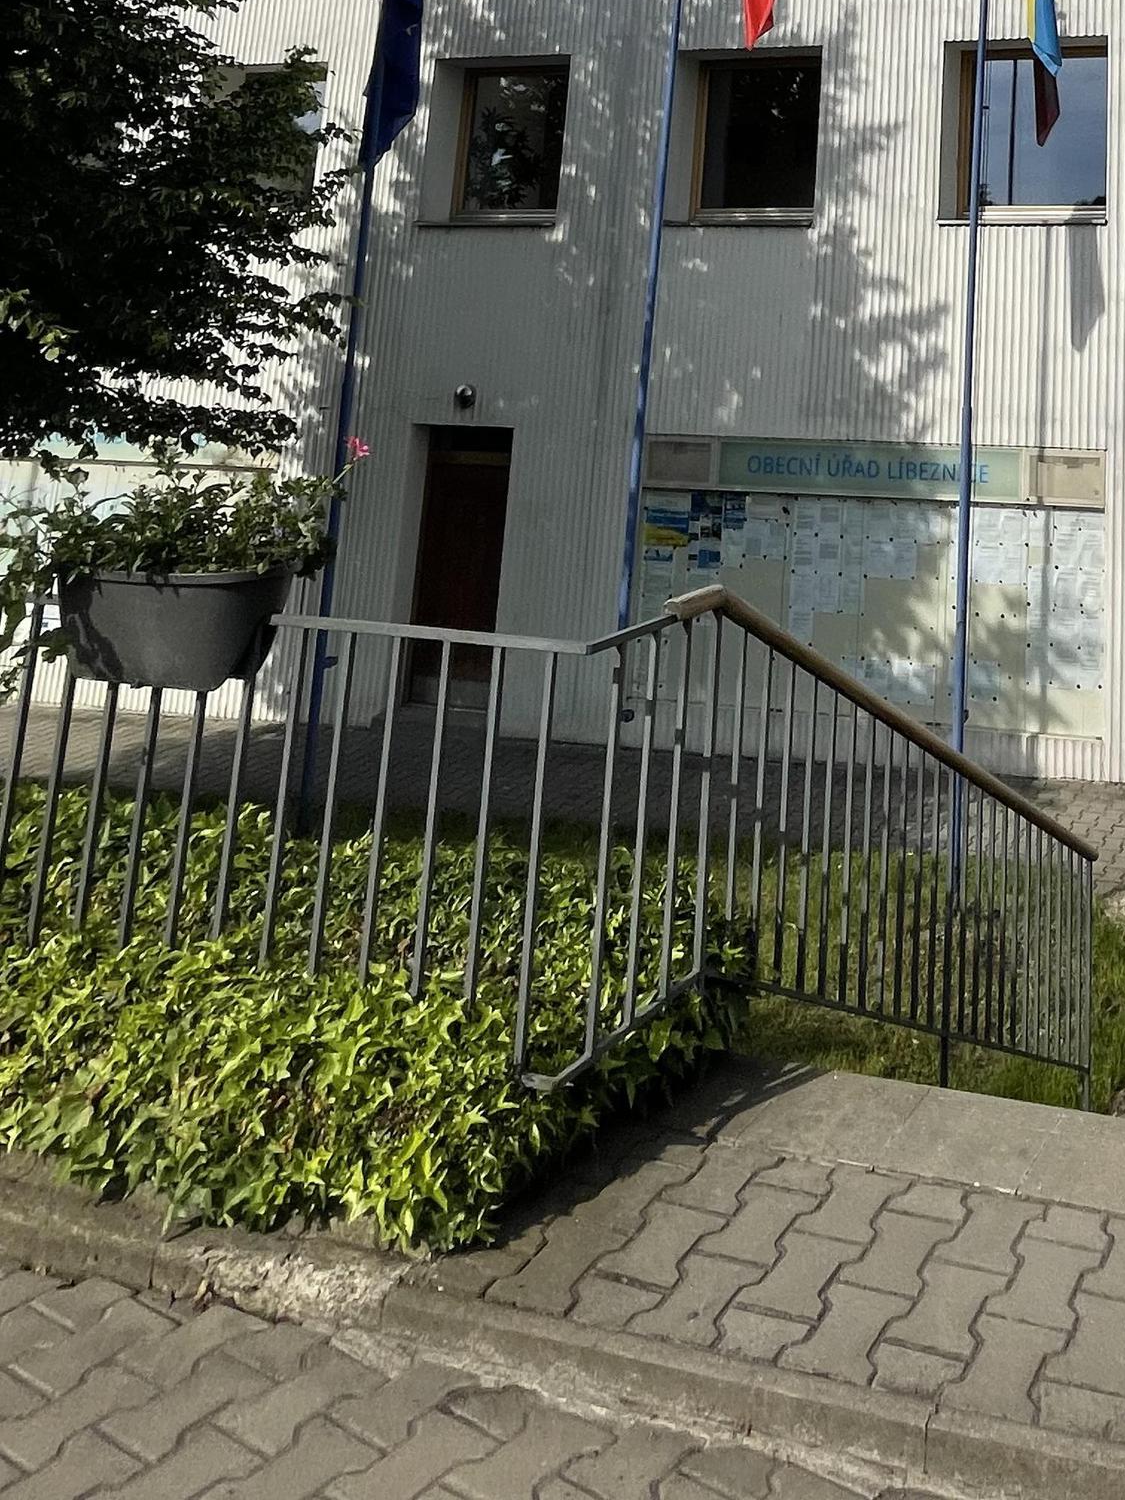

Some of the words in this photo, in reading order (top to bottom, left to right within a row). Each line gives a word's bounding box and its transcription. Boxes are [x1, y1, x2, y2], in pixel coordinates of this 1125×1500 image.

[747, 452, 821, 476] OBECNÍ
[827, 452, 880, 478] ÚŘAD
[887, 456, 989, 484] LÍBEZNE
